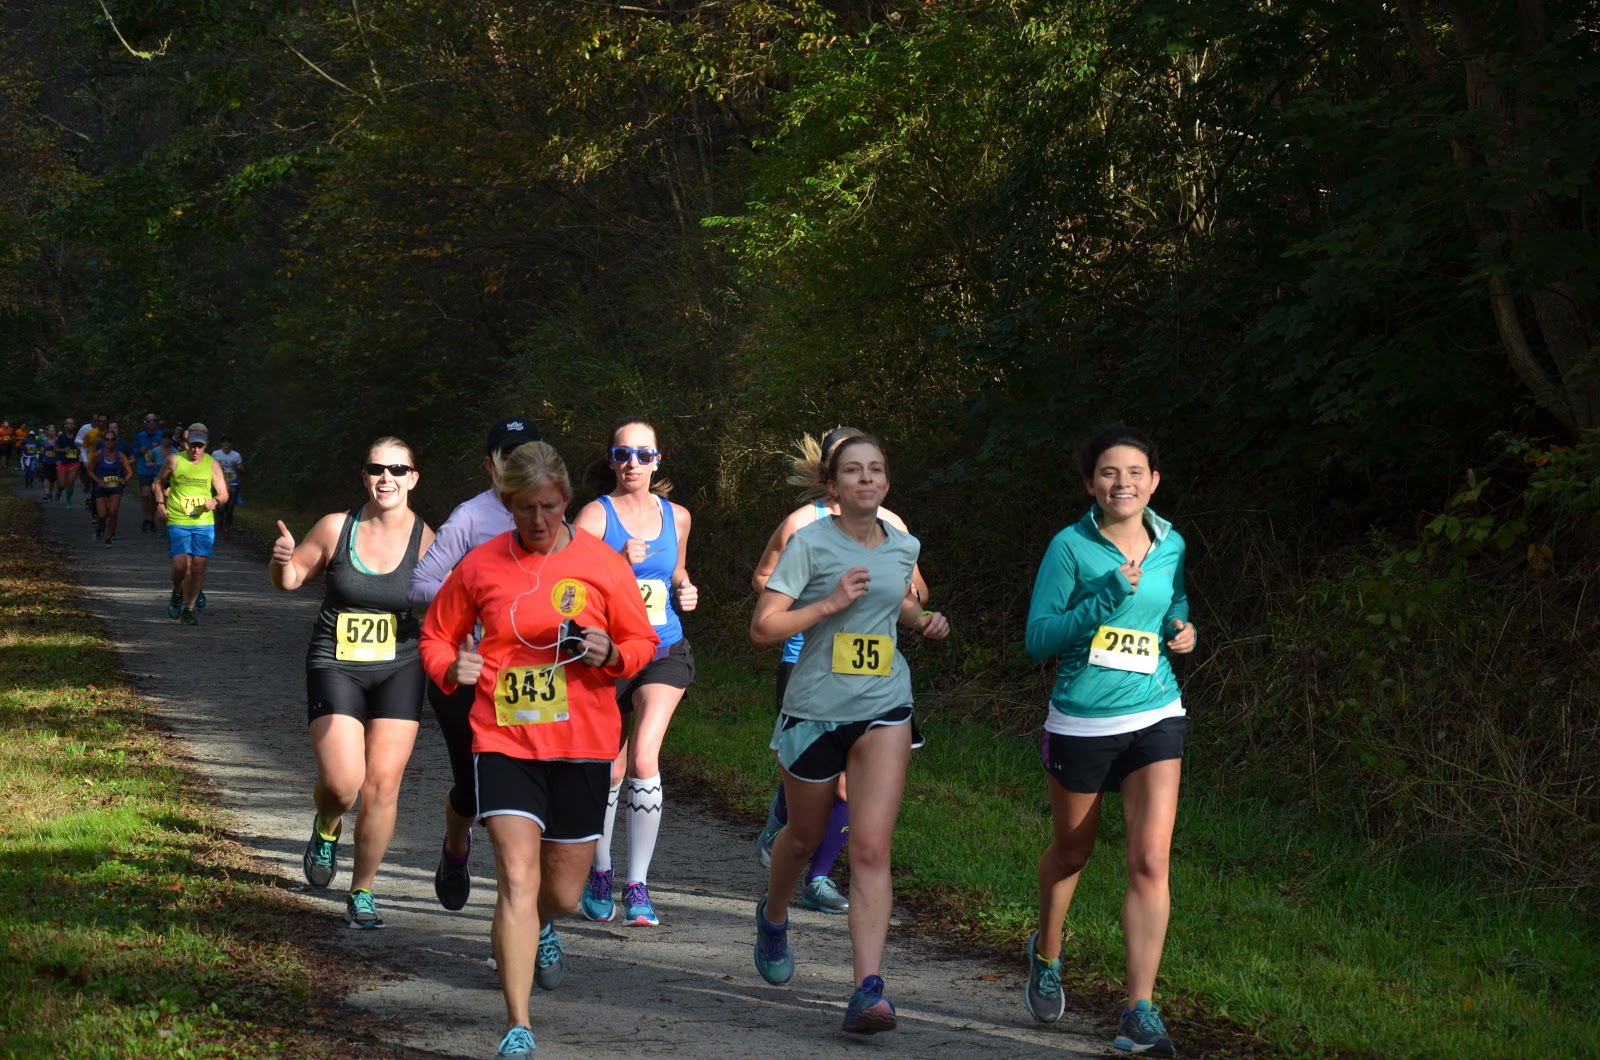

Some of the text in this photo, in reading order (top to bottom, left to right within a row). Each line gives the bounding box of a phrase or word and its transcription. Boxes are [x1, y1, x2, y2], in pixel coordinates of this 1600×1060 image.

[184, 497, 202, 509] 741
[346, 618, 389, 644] 520
[851, 638, 880, 670] 35
[504, 668, 556, 705] 343
